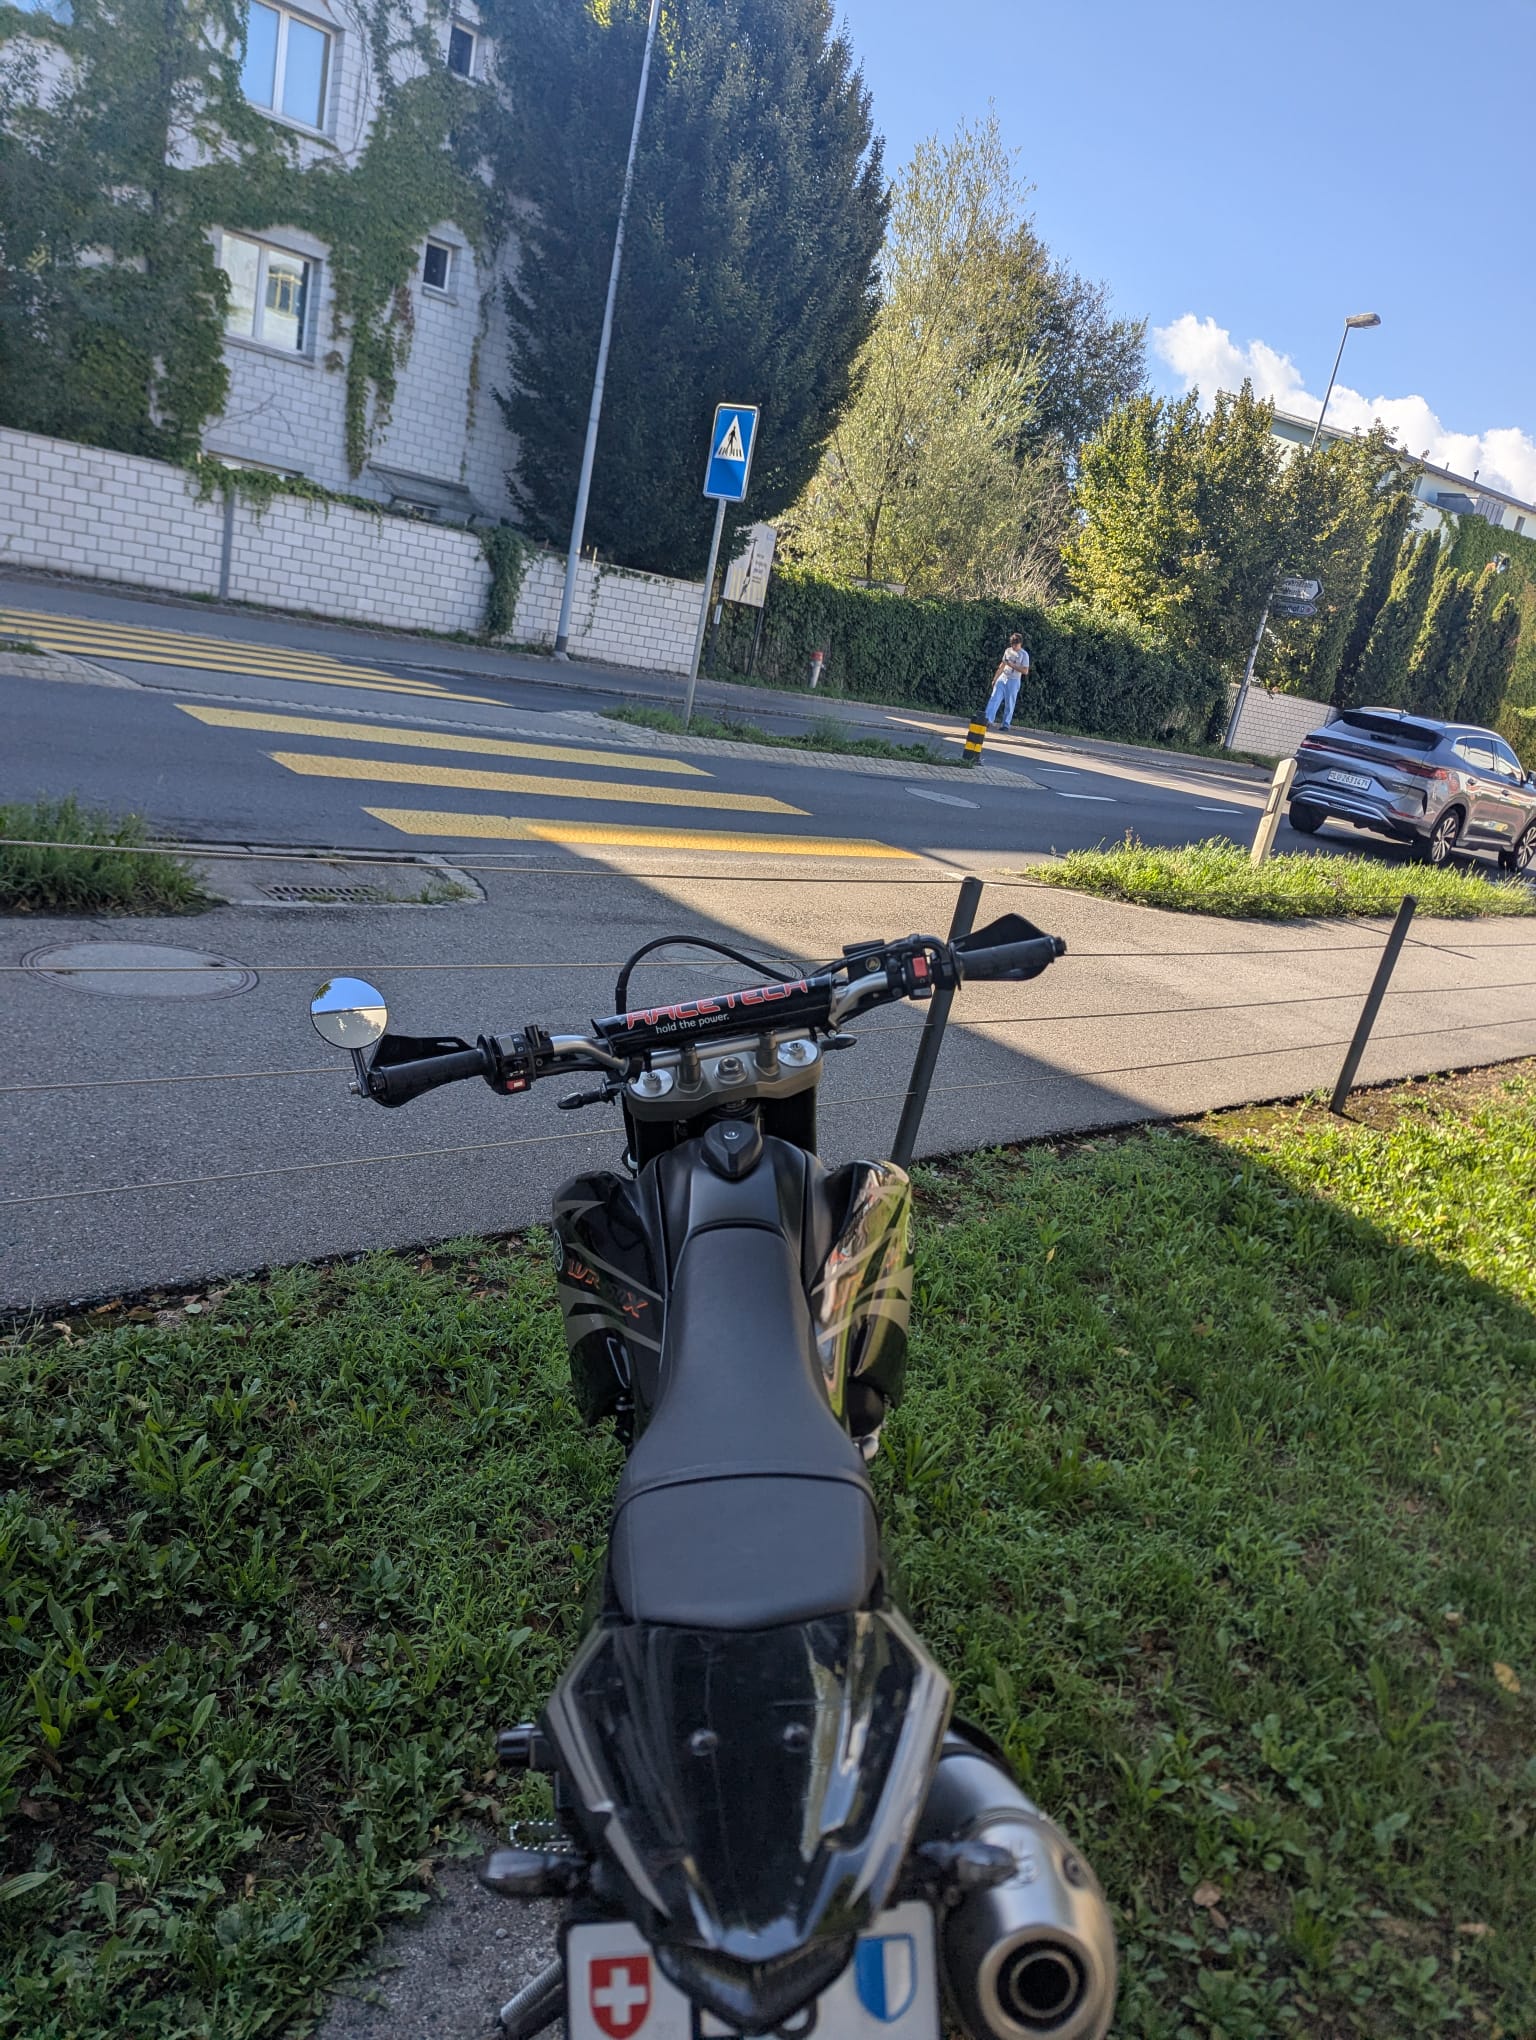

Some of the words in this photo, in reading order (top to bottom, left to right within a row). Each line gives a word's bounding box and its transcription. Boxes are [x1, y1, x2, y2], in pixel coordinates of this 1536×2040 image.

[655, 1022, 678, 1035] hold
[679, 1018, 697, 1031] the
[698, 1012, 731, 1029] power.
